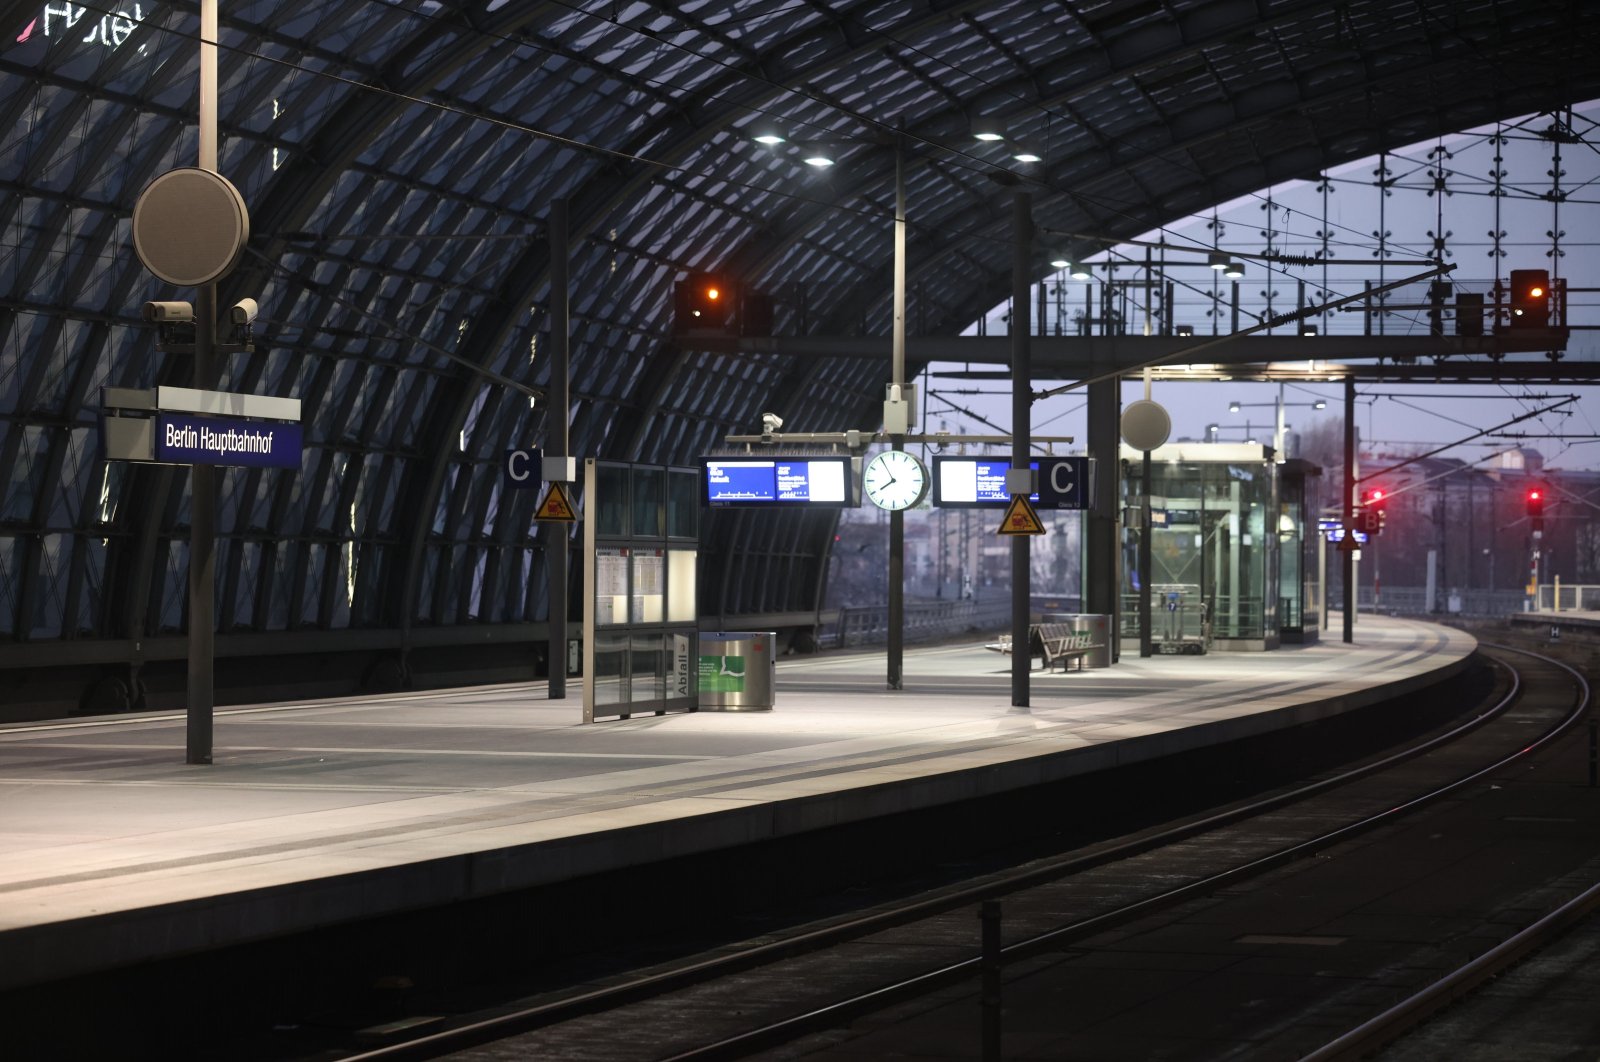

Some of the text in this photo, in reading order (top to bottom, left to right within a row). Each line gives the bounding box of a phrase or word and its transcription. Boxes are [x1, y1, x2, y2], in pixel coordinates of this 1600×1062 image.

[166, 423, 273, 456] Berlin Hauptbahnhof
[508, 451, 530, 481] C
[1050, 462, 1074, 494] C
[1365, 513, 1377, 530] B
[1533, 551, 1540, 559] H
[1551, 627, 1559, 637] H
[678, 655, 687, 695] Abfall
